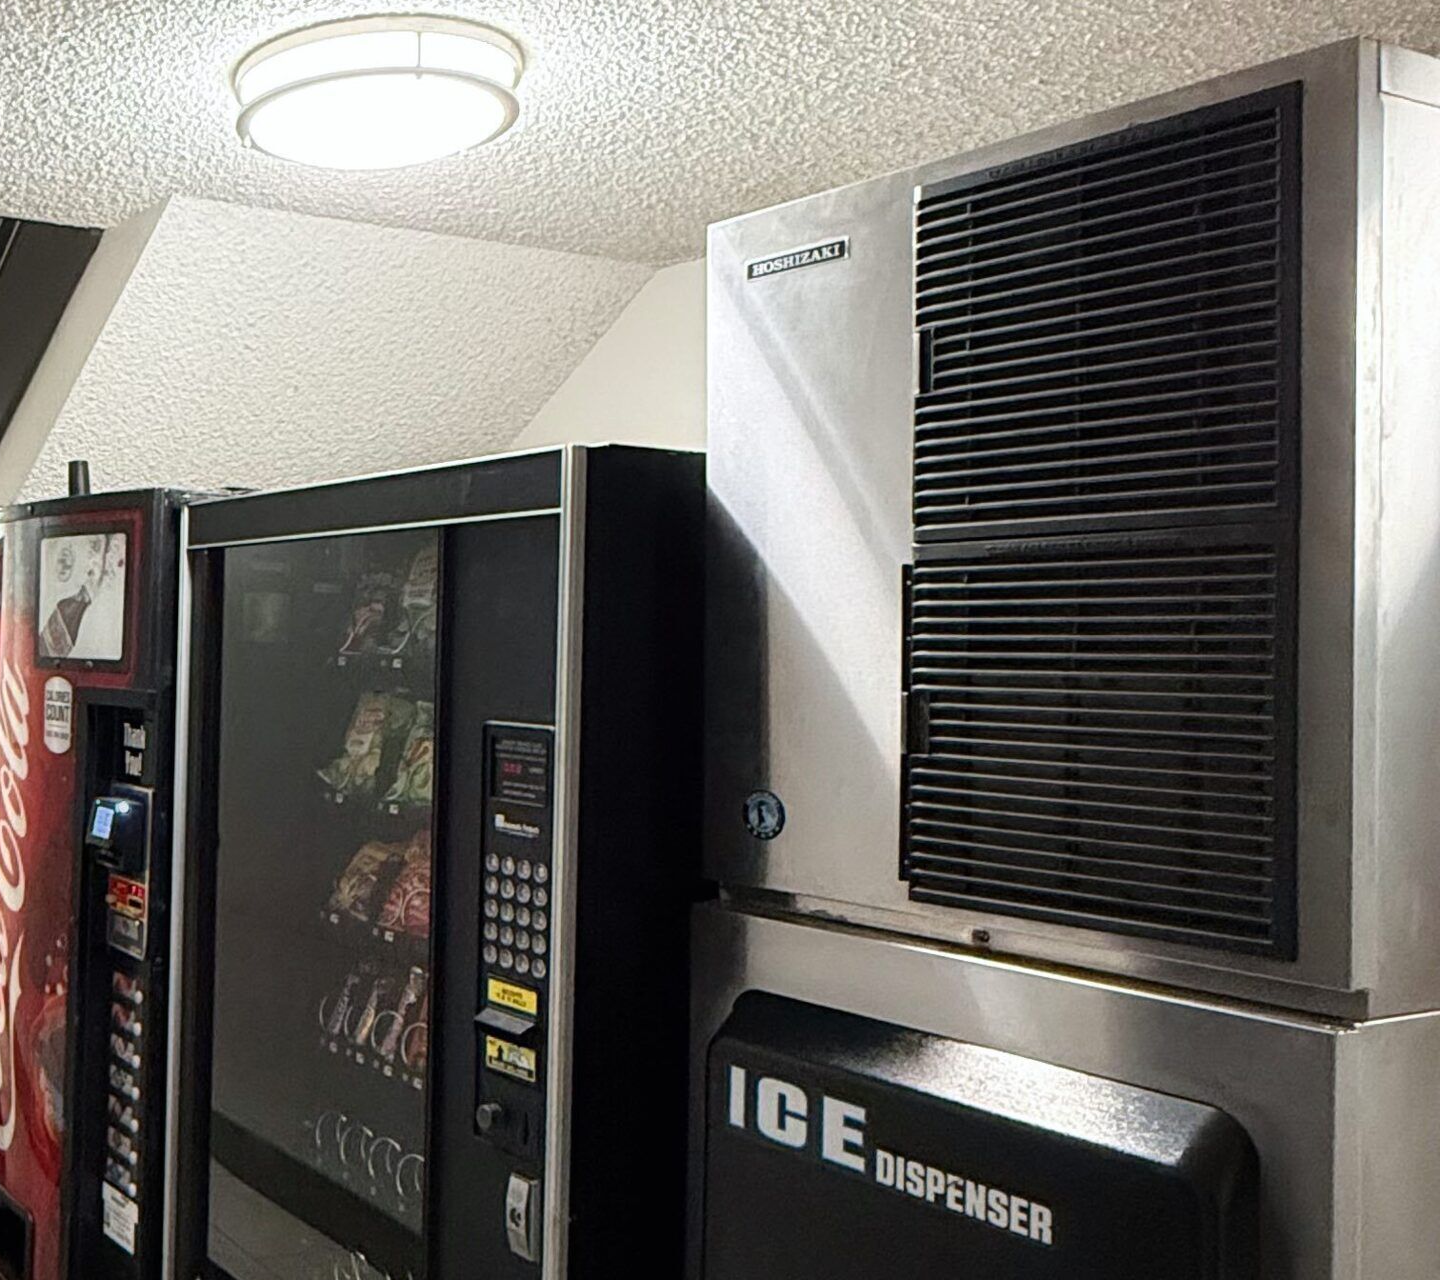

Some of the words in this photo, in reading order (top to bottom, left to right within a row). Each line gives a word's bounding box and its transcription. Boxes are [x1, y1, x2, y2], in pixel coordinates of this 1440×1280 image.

[752, 244, 840, 277] HOSHIZAKI
[728, 1064, 866, 1172] ICE
[875, 1148, 1053, 1246] DISPENSER
